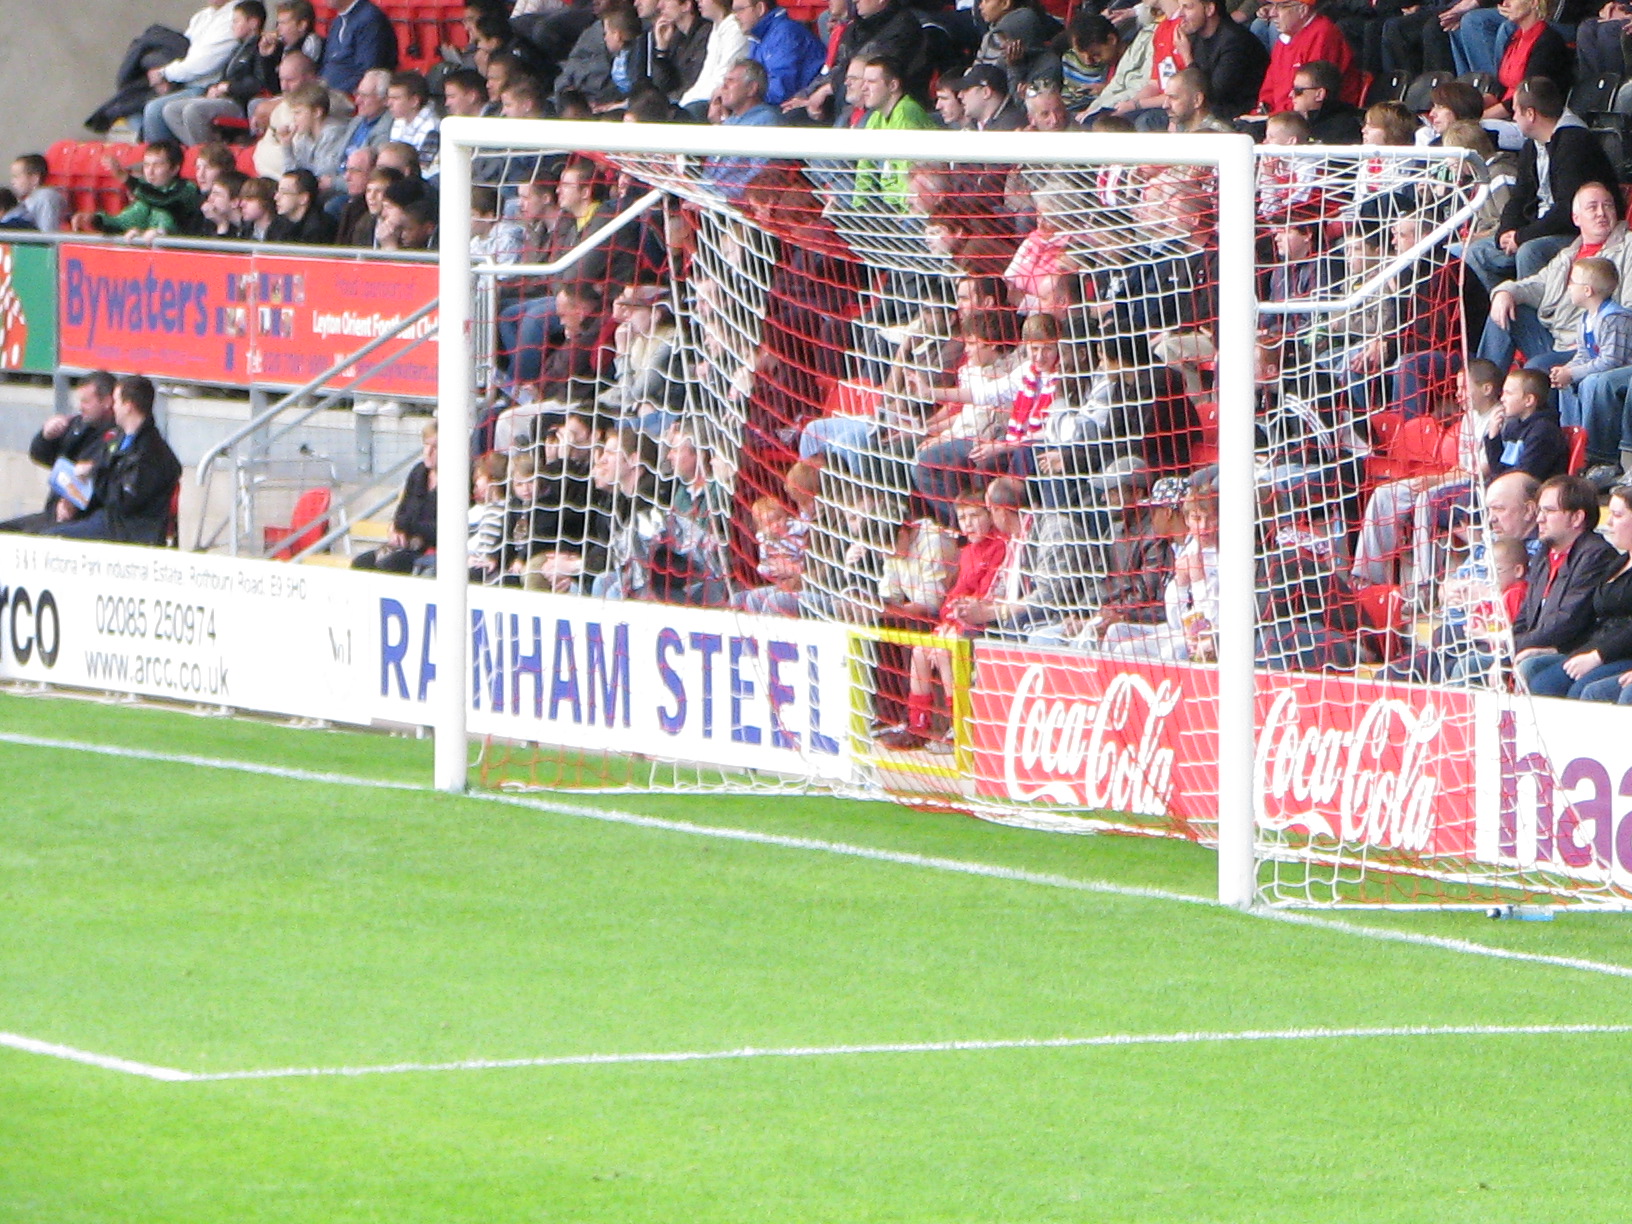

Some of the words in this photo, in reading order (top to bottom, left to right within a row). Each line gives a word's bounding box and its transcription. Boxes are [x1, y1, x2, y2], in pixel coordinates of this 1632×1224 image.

[66, 258, 208, 350] Bywaters
[95, 594, 147, 637] 02085
[154, 600, 217, 646] 250974
[379, 596, 632, 729] RANHAM
[656, 627, 840, 756] STEEL
[1003, 663, 1182, 816] Coca-Cola
[1253, 687, 1447, 851] Coca-Cola
